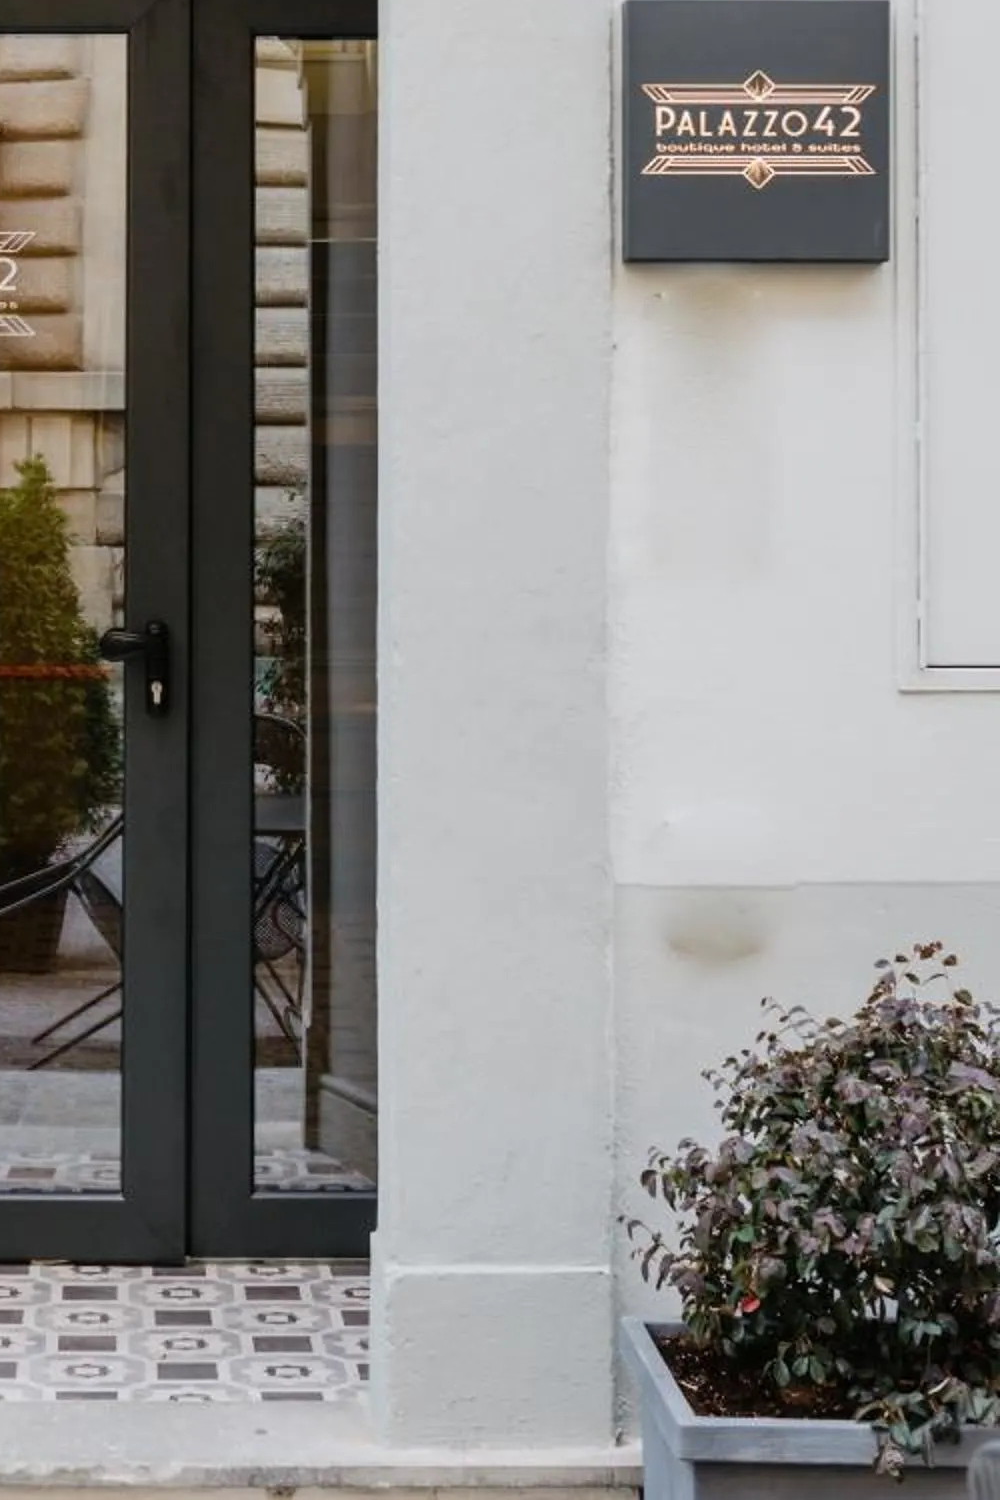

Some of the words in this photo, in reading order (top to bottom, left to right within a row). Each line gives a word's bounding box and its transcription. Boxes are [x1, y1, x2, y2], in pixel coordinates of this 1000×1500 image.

[655, 105, 862, 137] PALAZZO42
[655, 142, 735, 153] boutique
[741, 142, 787, 153] hotel
[791, 143, 803, 153] &
[807, 142, 861, 153] suites
